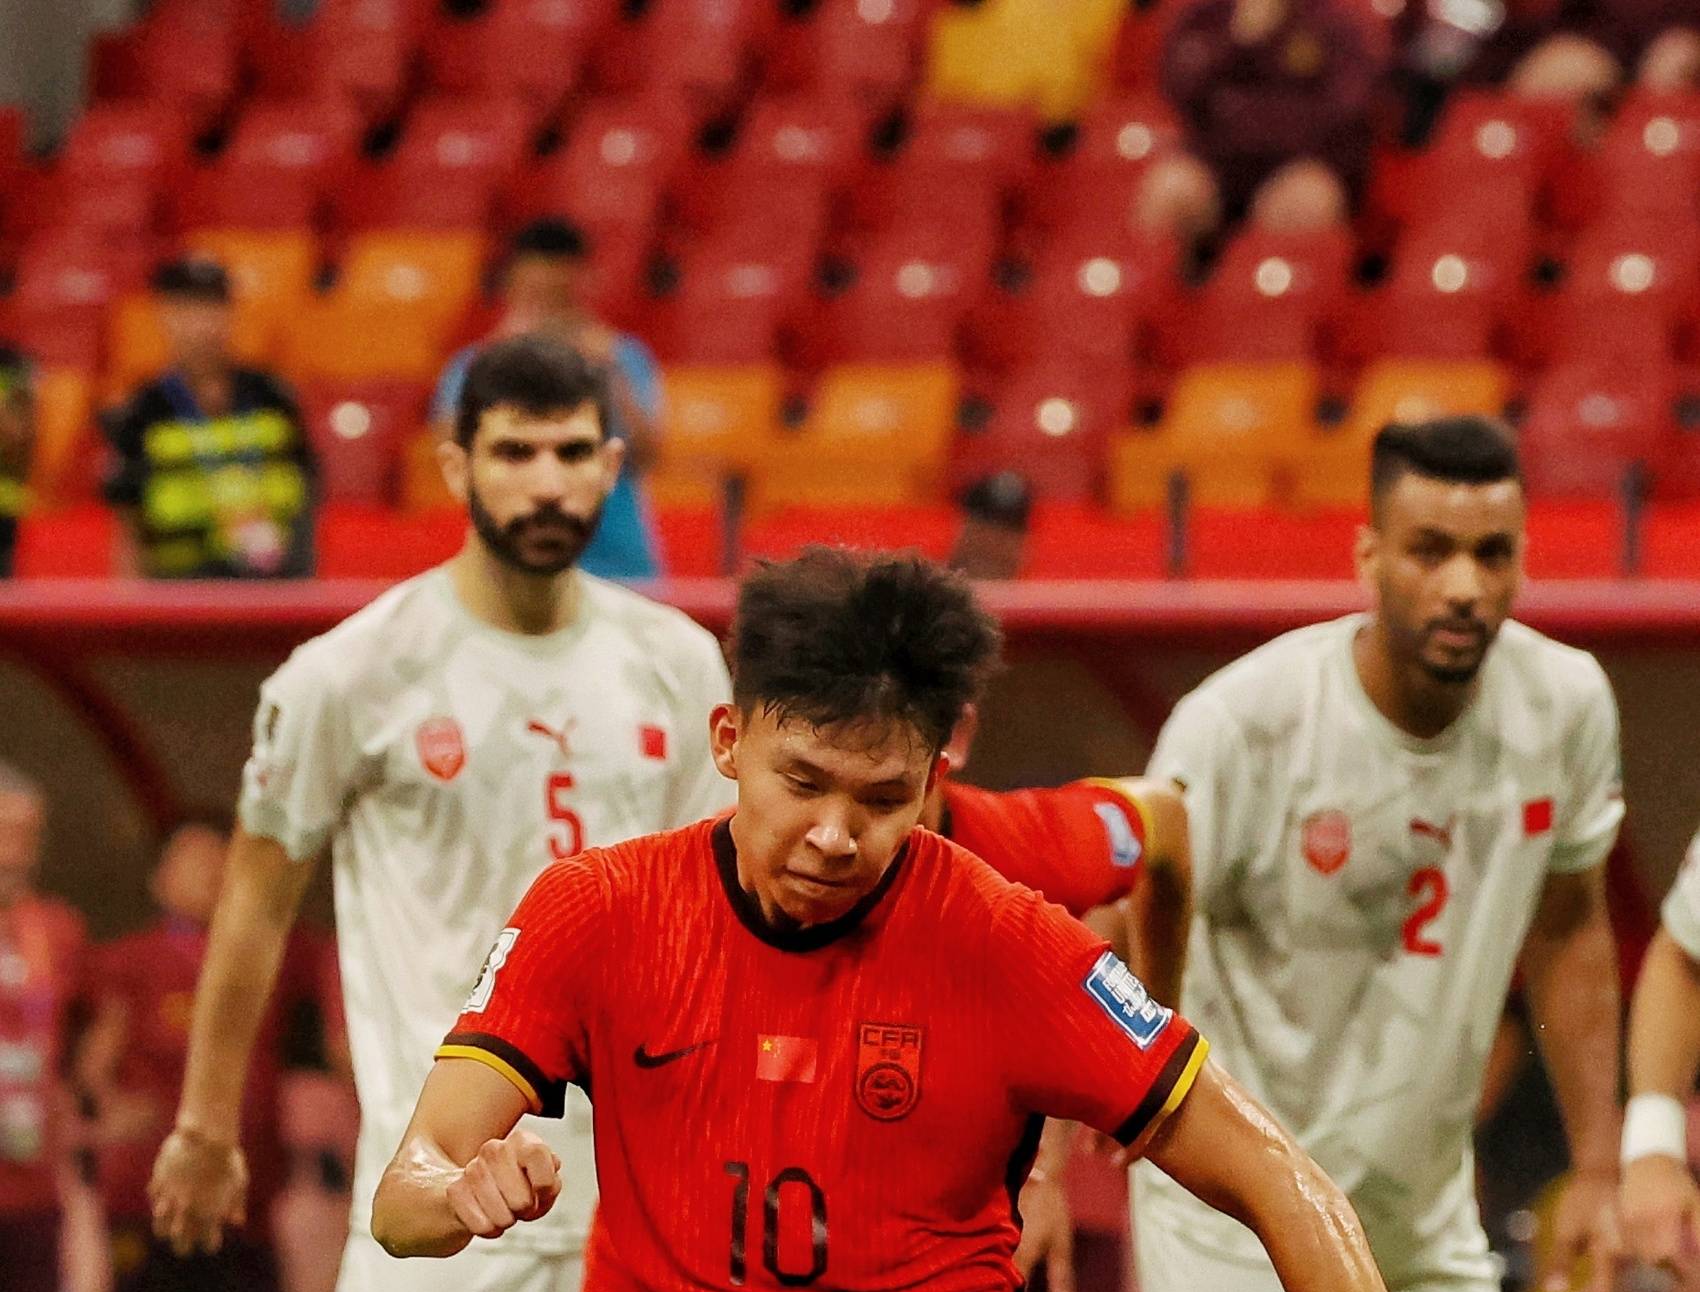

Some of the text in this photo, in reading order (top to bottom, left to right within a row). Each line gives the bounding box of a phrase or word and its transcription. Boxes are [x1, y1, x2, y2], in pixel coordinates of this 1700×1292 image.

[545, 772, 583, 859] 5
[1402, 866, 1449, 957] 2
[862, 1029, 919, 1048] CFA
[724, 1161, 828, 1287] 10
